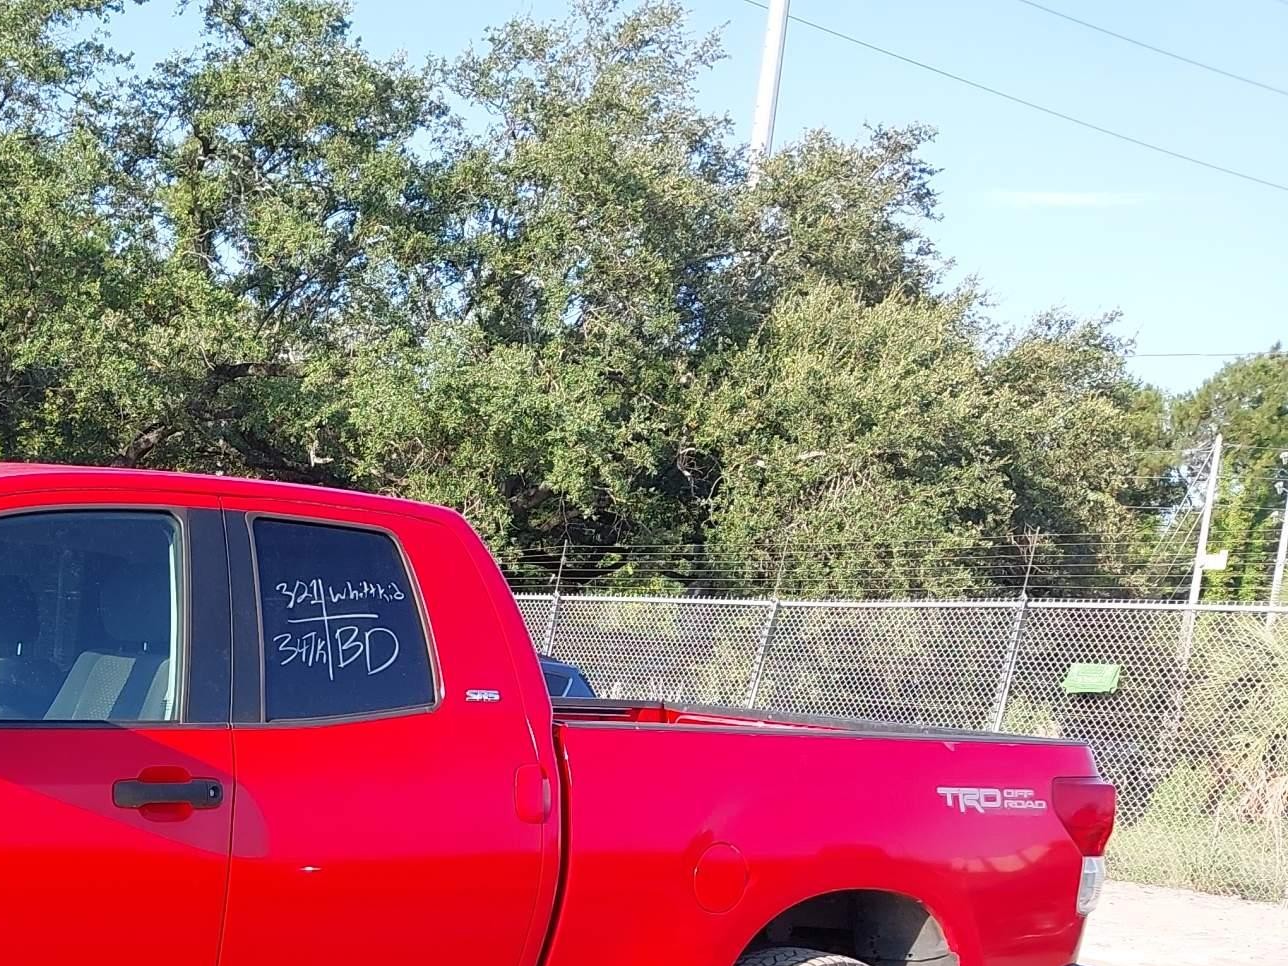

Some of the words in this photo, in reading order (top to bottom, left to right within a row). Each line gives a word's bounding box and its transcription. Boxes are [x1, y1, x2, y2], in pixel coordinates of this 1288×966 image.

[335, 625, 400, 675] BD
[936, 787, 1002, 813] TRD
[1003, 789, 1035, 799] OFF
[1003, 800, 1048, 809] ROAD
